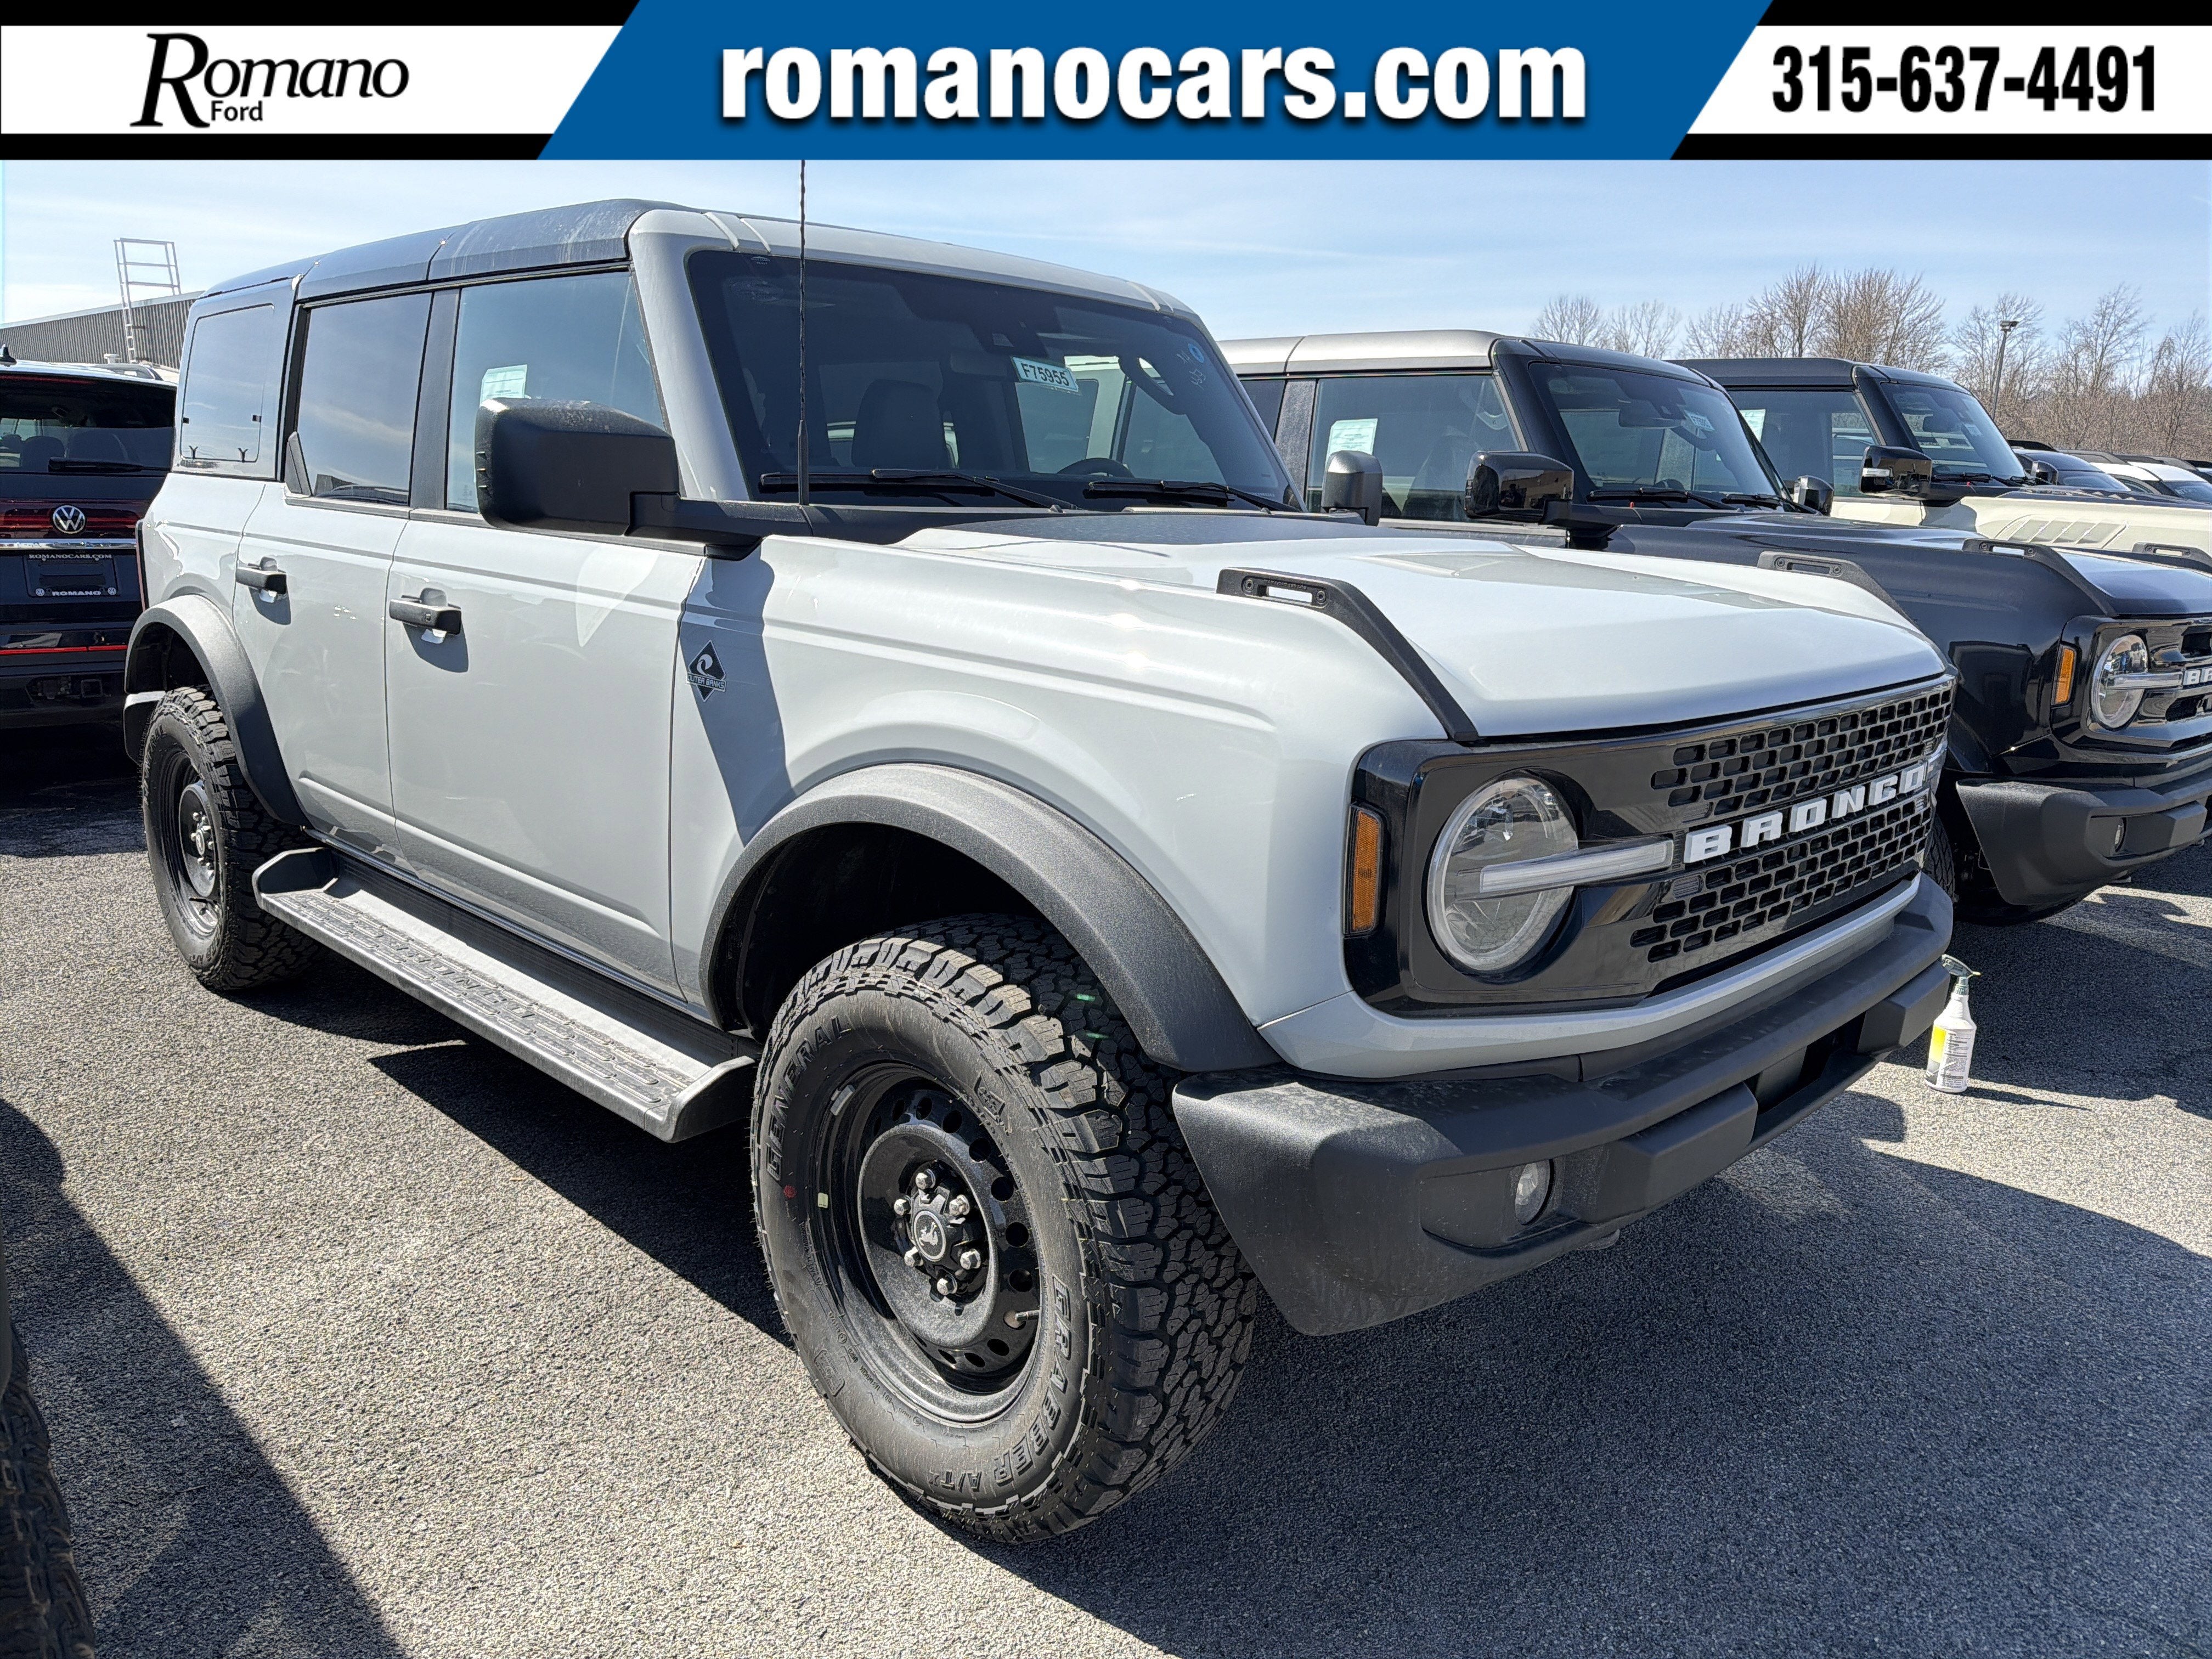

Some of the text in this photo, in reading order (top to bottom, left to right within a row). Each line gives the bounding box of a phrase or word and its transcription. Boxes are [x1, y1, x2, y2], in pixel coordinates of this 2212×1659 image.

[1021, 363, 1069, 386] F75955
[687, 674, 725, 689] OUTER BANKS
[1684, 763, 1926, 864] BRONCO
[766, 1015, 851, 1181] GENERAL
[994, 1274, 1072, 1487] GRABBER
